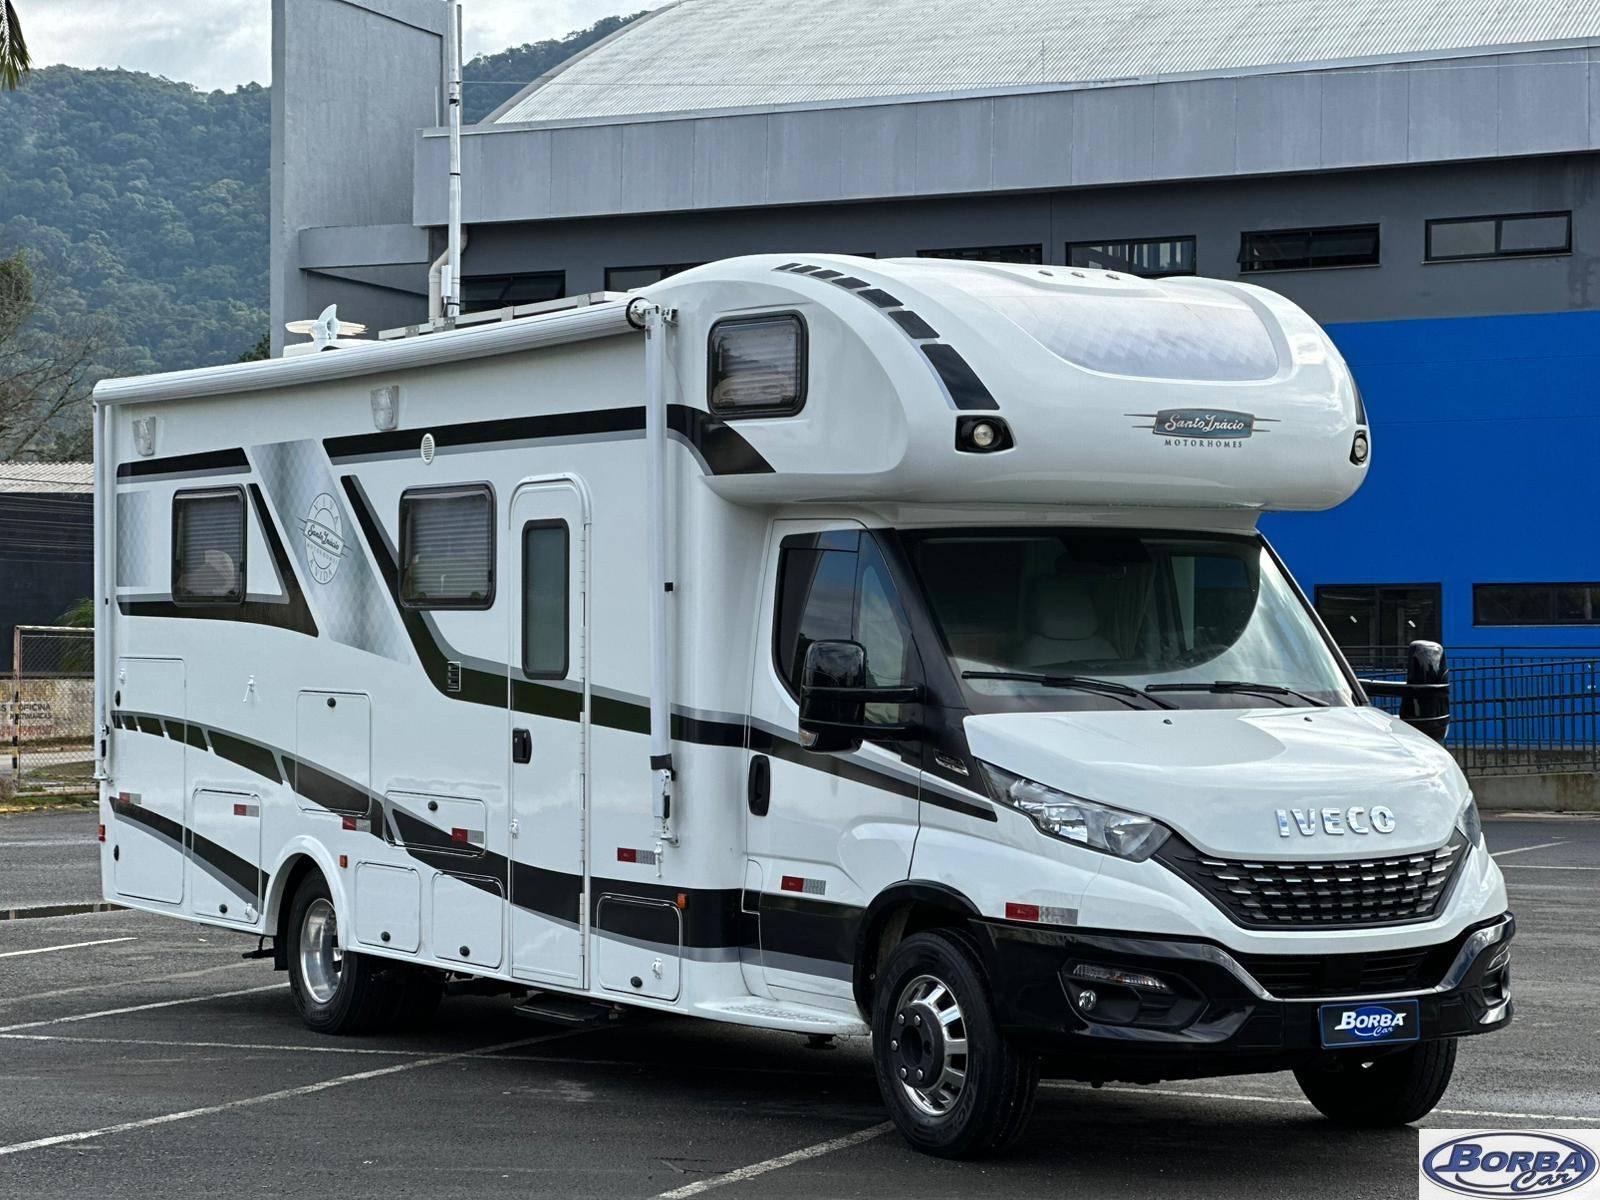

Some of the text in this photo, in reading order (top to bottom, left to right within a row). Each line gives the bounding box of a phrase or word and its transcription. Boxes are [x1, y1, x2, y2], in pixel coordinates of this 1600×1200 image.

[1164, 413, 1245, 432] Santo Inácio
[1164, 439, 1243, 448] MOTORHOMES
[307, 524, 323, 541] Santo
[18, 703, 51, 711] OFICINA
[1275, 805, 1396, 837] IVECO
[1334, 1011, 1407, 1030] BORBA
[1372, 1026, 1394, 1037] Car
